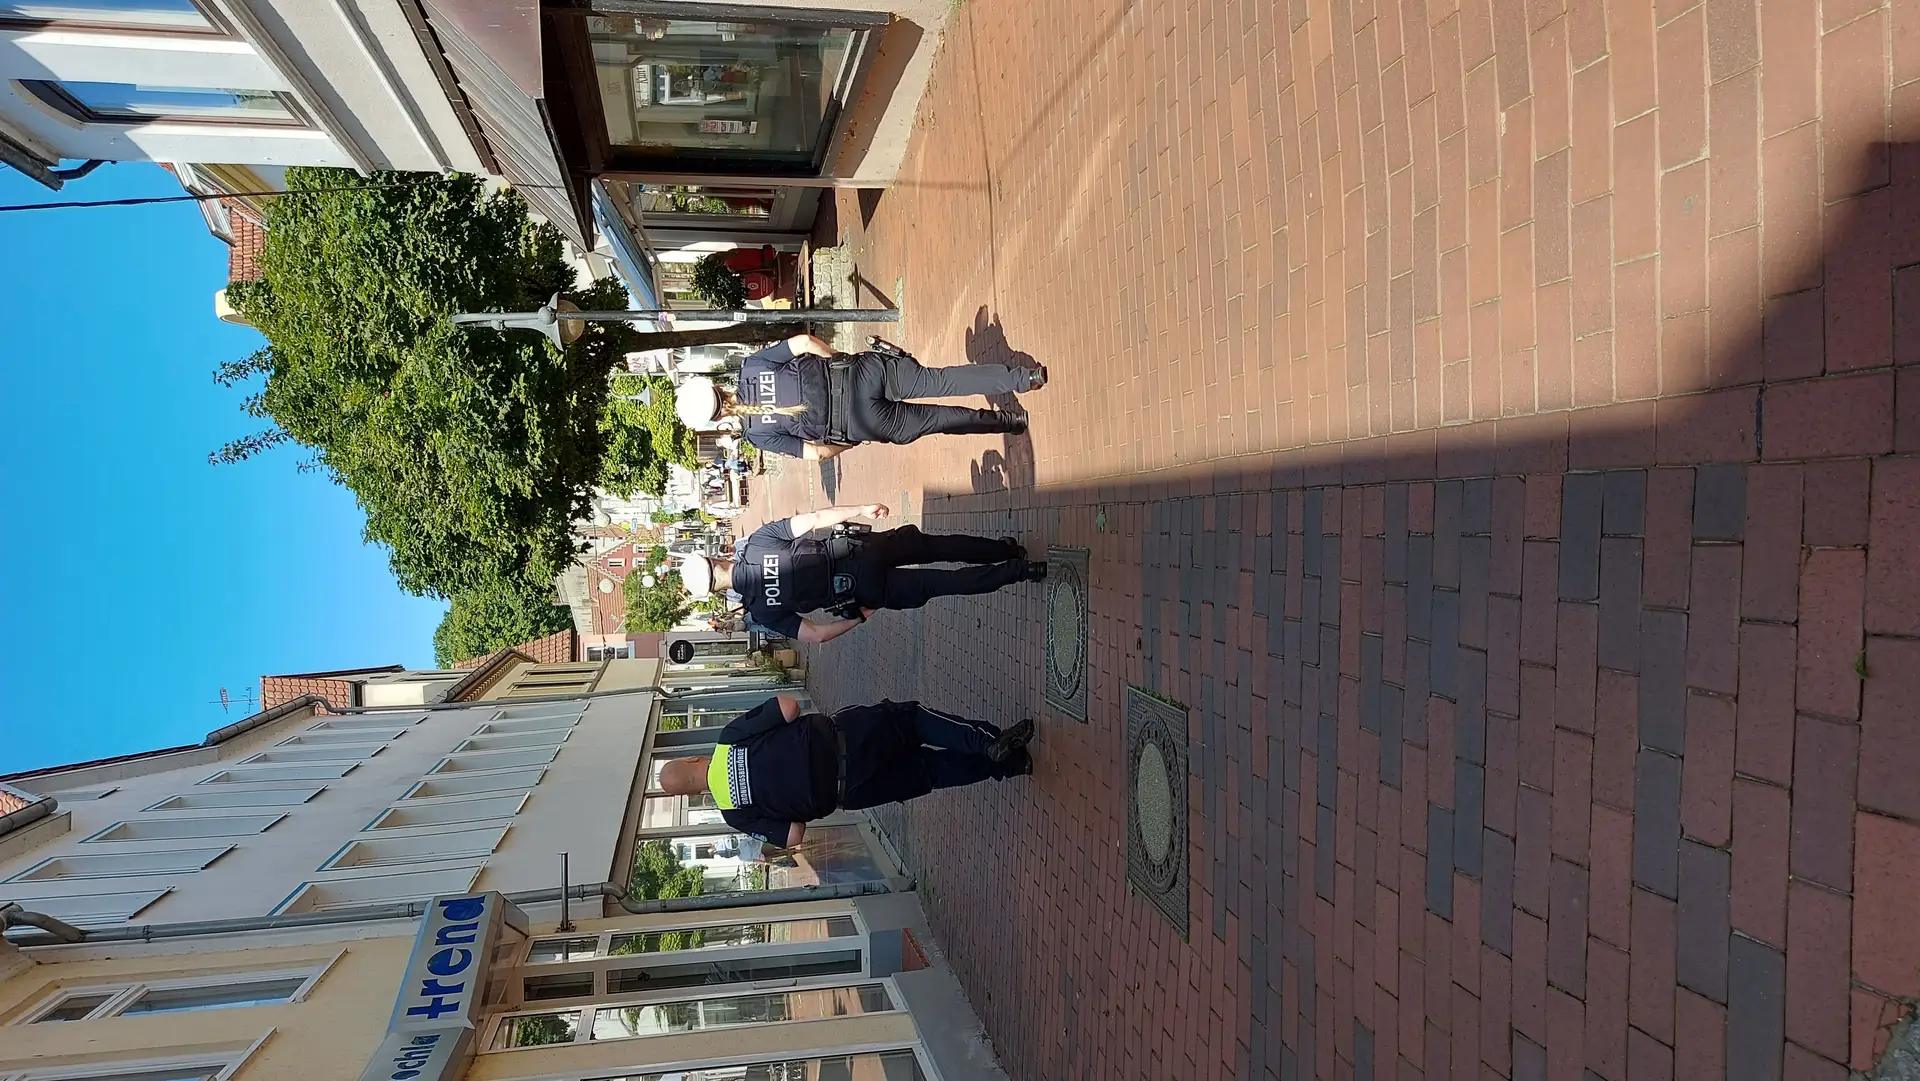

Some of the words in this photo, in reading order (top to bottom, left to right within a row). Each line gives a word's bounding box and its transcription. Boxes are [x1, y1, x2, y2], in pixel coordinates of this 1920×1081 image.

[763, 554, 781, 606] POLIZEI
[735, 748, 749, 805] ORDNUNGSBEHÖRDE
[406, 895, 486, 1020] trend
